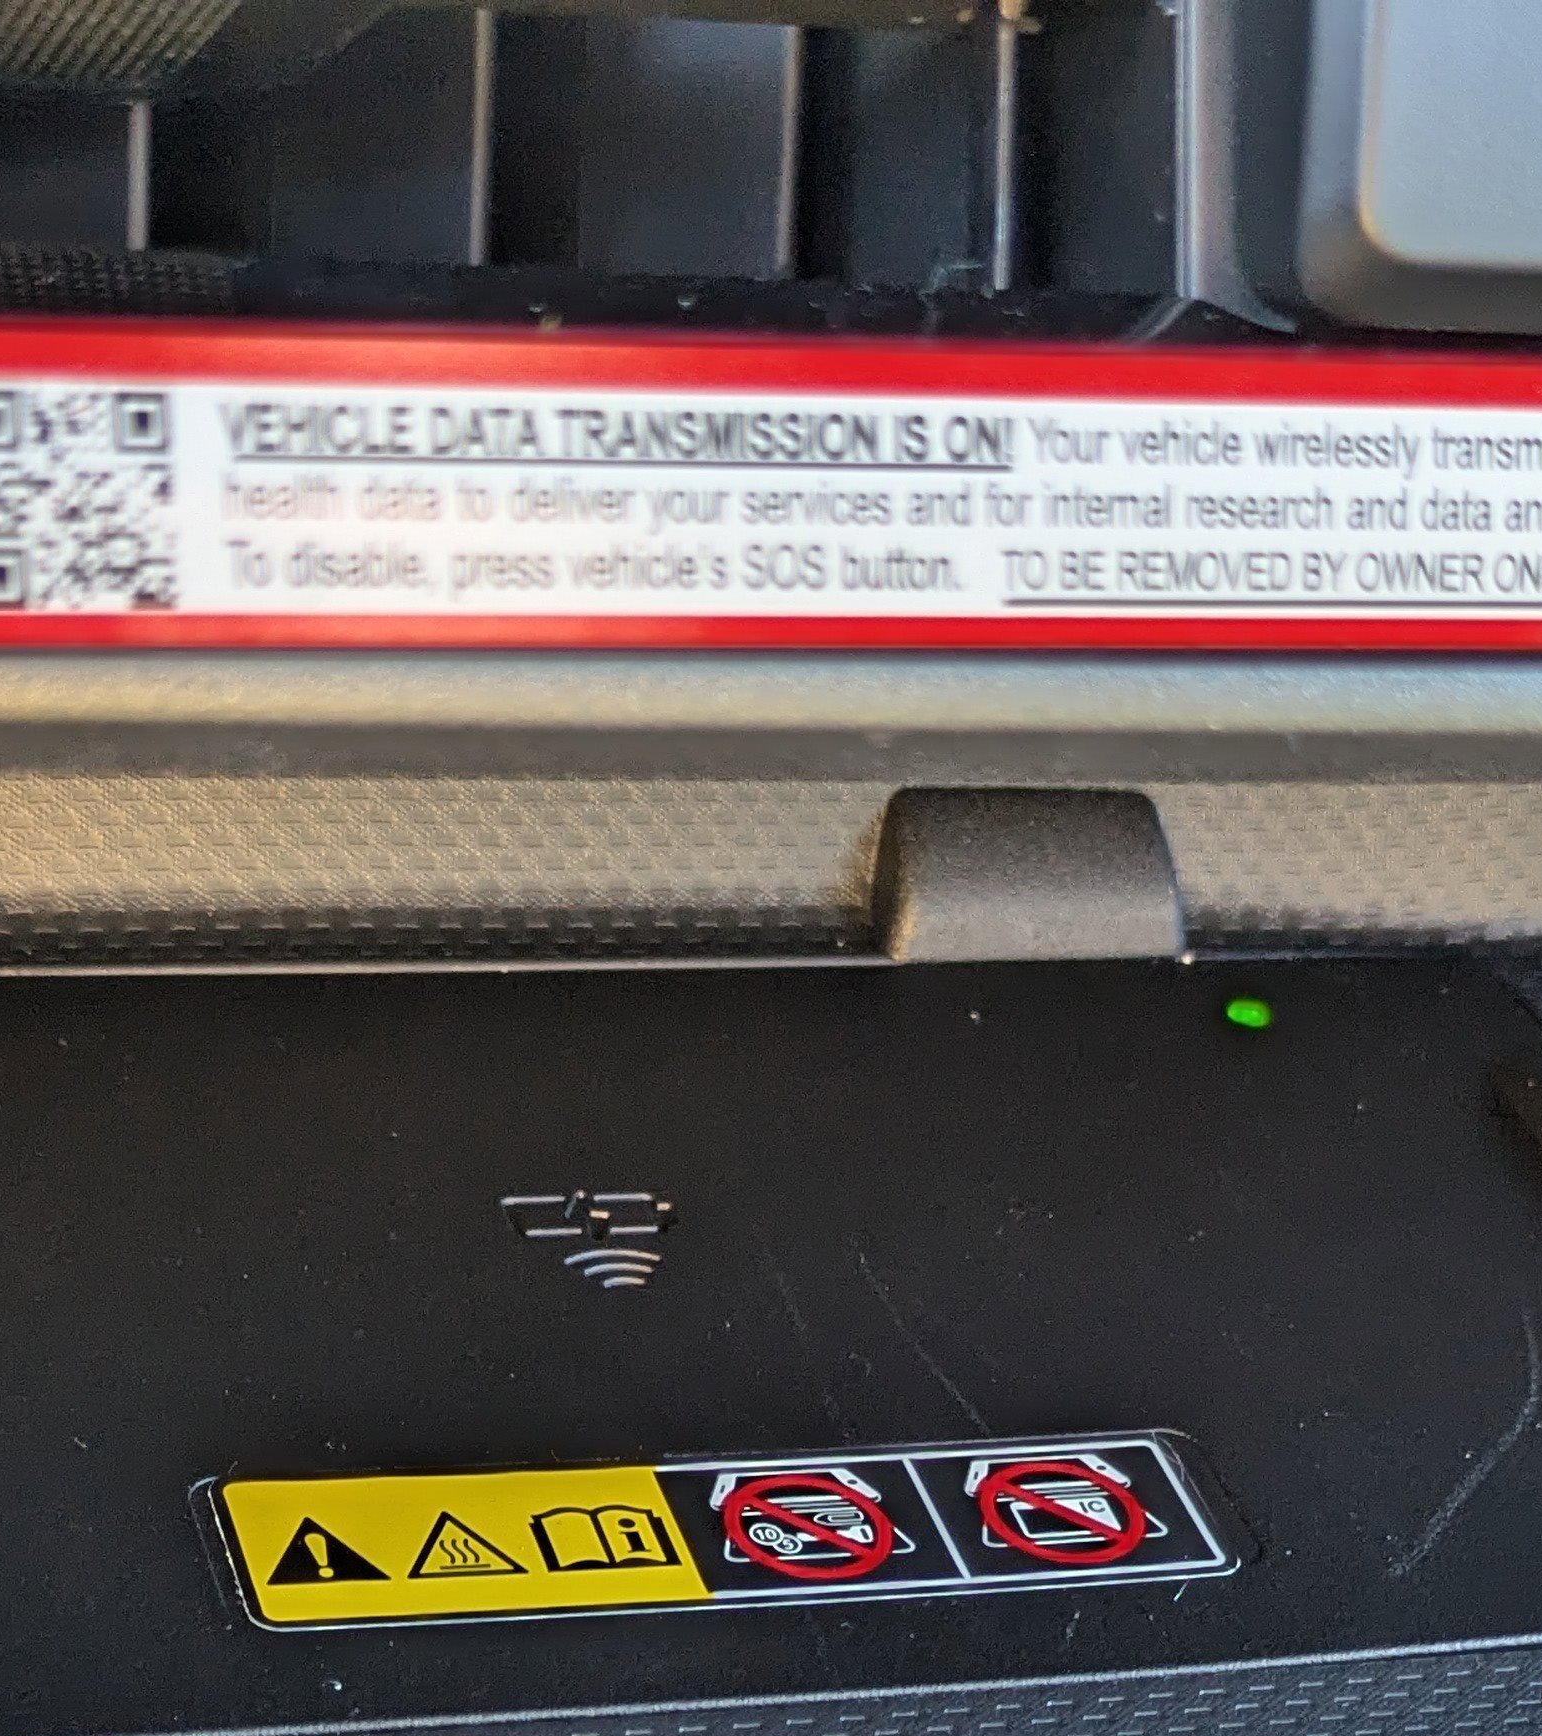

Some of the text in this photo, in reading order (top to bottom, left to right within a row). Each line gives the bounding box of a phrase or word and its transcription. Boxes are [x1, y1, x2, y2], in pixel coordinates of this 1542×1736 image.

[219, 402, 414, 454] VEHICLE
[430, 405, 543, 455] DATA
[555, 407, 877, 461] TRANSMISSION
[894, 413, 929, 461] IS
[943, 414, 1015, 464] ON!
[1025, 415, 1109, 464] Your
[1119, 418, 1242, 466] vehicle
[1253, 418, 1419, 479] wirelessly
[225, 473, 341, 521] health
[361, 476, 443, 522] data
[457, 478, 495, 522] to
[511, 478, 637, 523] deliver
[645, 488, 731, 535] your
[742, 480, 893, 528] services
[907, 482, 972, 528] and
[984, 484, 1033, 528] for
[1041, 484, 1172, 530] internal
[1186, 485, 1333, 531] research
[1345, 489, 1407, 531] and
[1420, 491, 1494, 533] data
[226, 539, 273, 588] To
[284, 543, 439, 595] disable,
[448, 550, 554, 600] press
[564, 545, 730, 590] vehicle's
[741, 545, 829, 592] SOS
[841, 548, 965, 592] button.
[1001, 550, 1050, 592] TO
[1061, 550, 1106, 592] BE
[1118, 550, 1291, 593] REMOVED
[1303, 551, 1351, 593] BY
[1357, 552, 1485, 593] OWNER
[1077, 1500, 1107, 1514] IC
